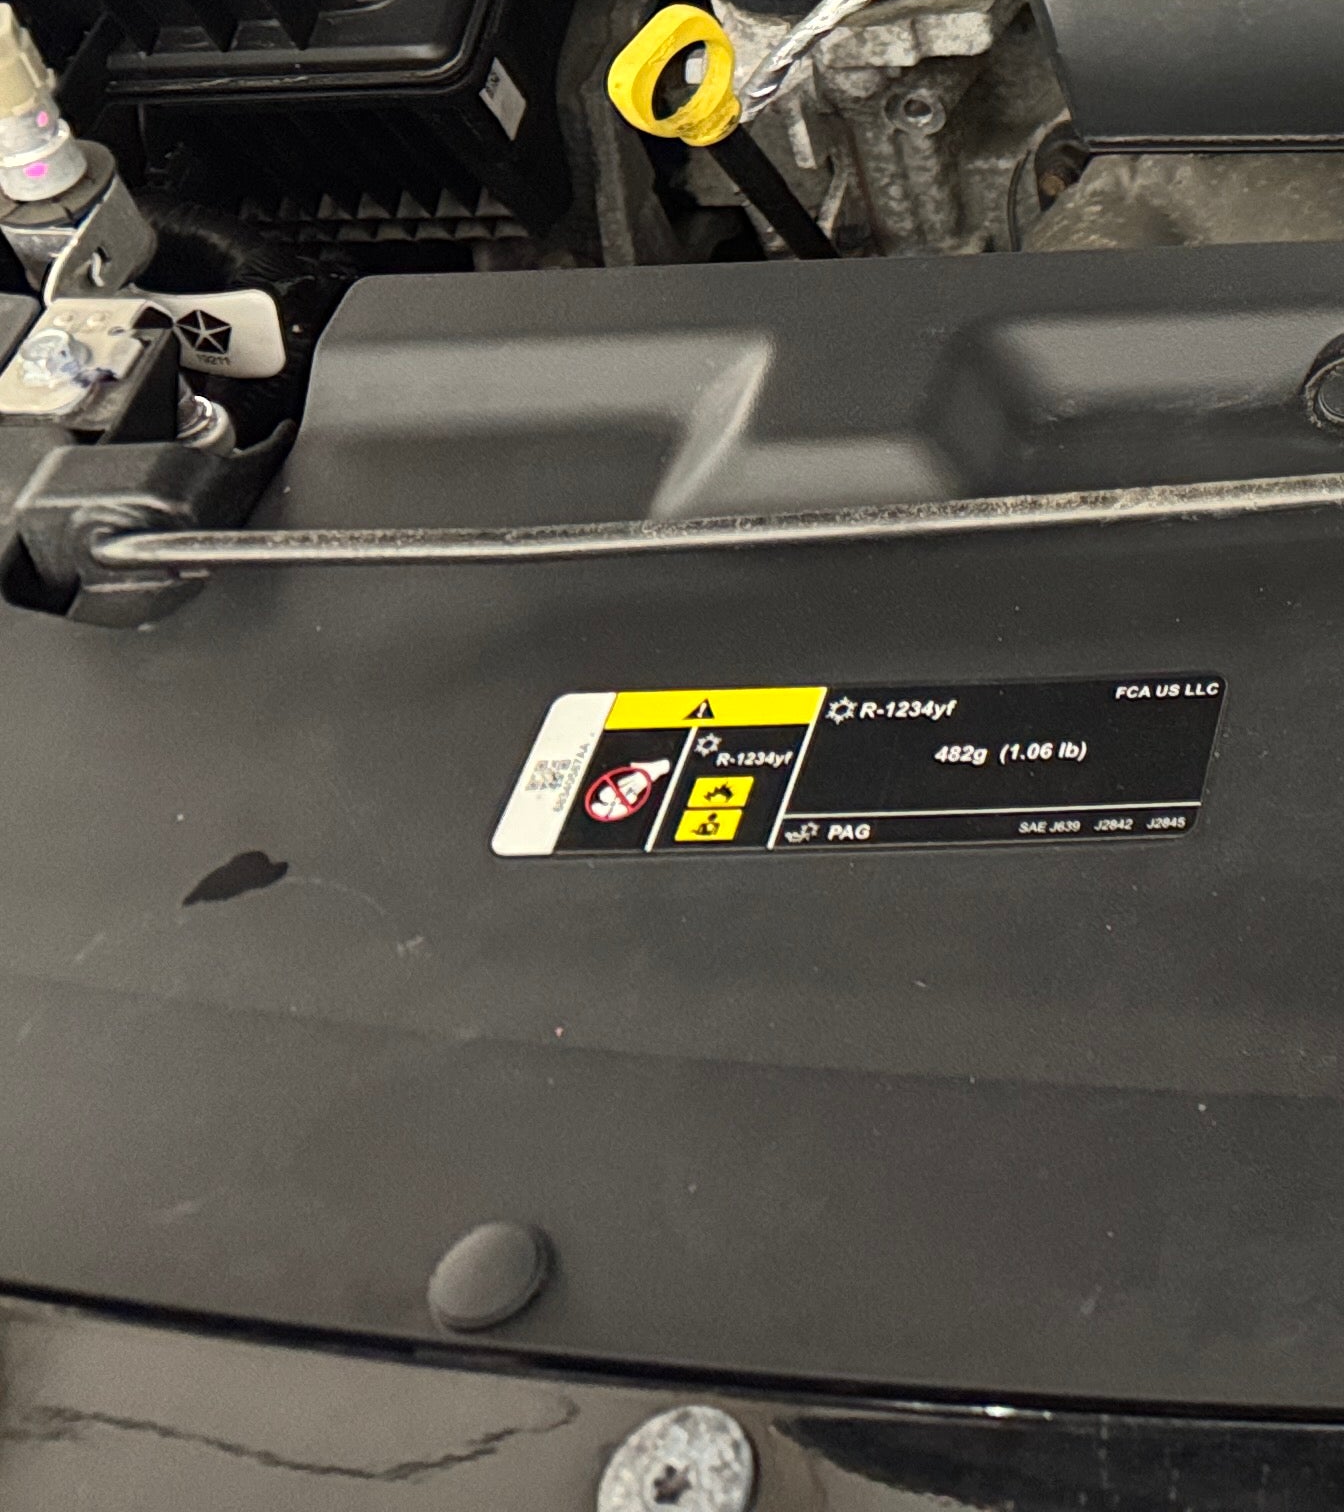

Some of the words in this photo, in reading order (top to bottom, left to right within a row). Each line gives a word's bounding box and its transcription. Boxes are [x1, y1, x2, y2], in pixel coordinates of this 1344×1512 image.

[1114, 685, 1151, 700] FCA
[1155, 684, 1180, 698] US
[1184, 682, 1220, 697] LLC
[859, 699, 958, 721] R-1234yf
[715, 751, 793, 768] R-1234yf
[934, 744, 988, 765] 482g
[999, 743, 1053, 765] (1.06
[1057, 741, 1088, 762] lb)
[827, 824, 871, 841] PAG
[1018, 821, 1048, 834] SAE
